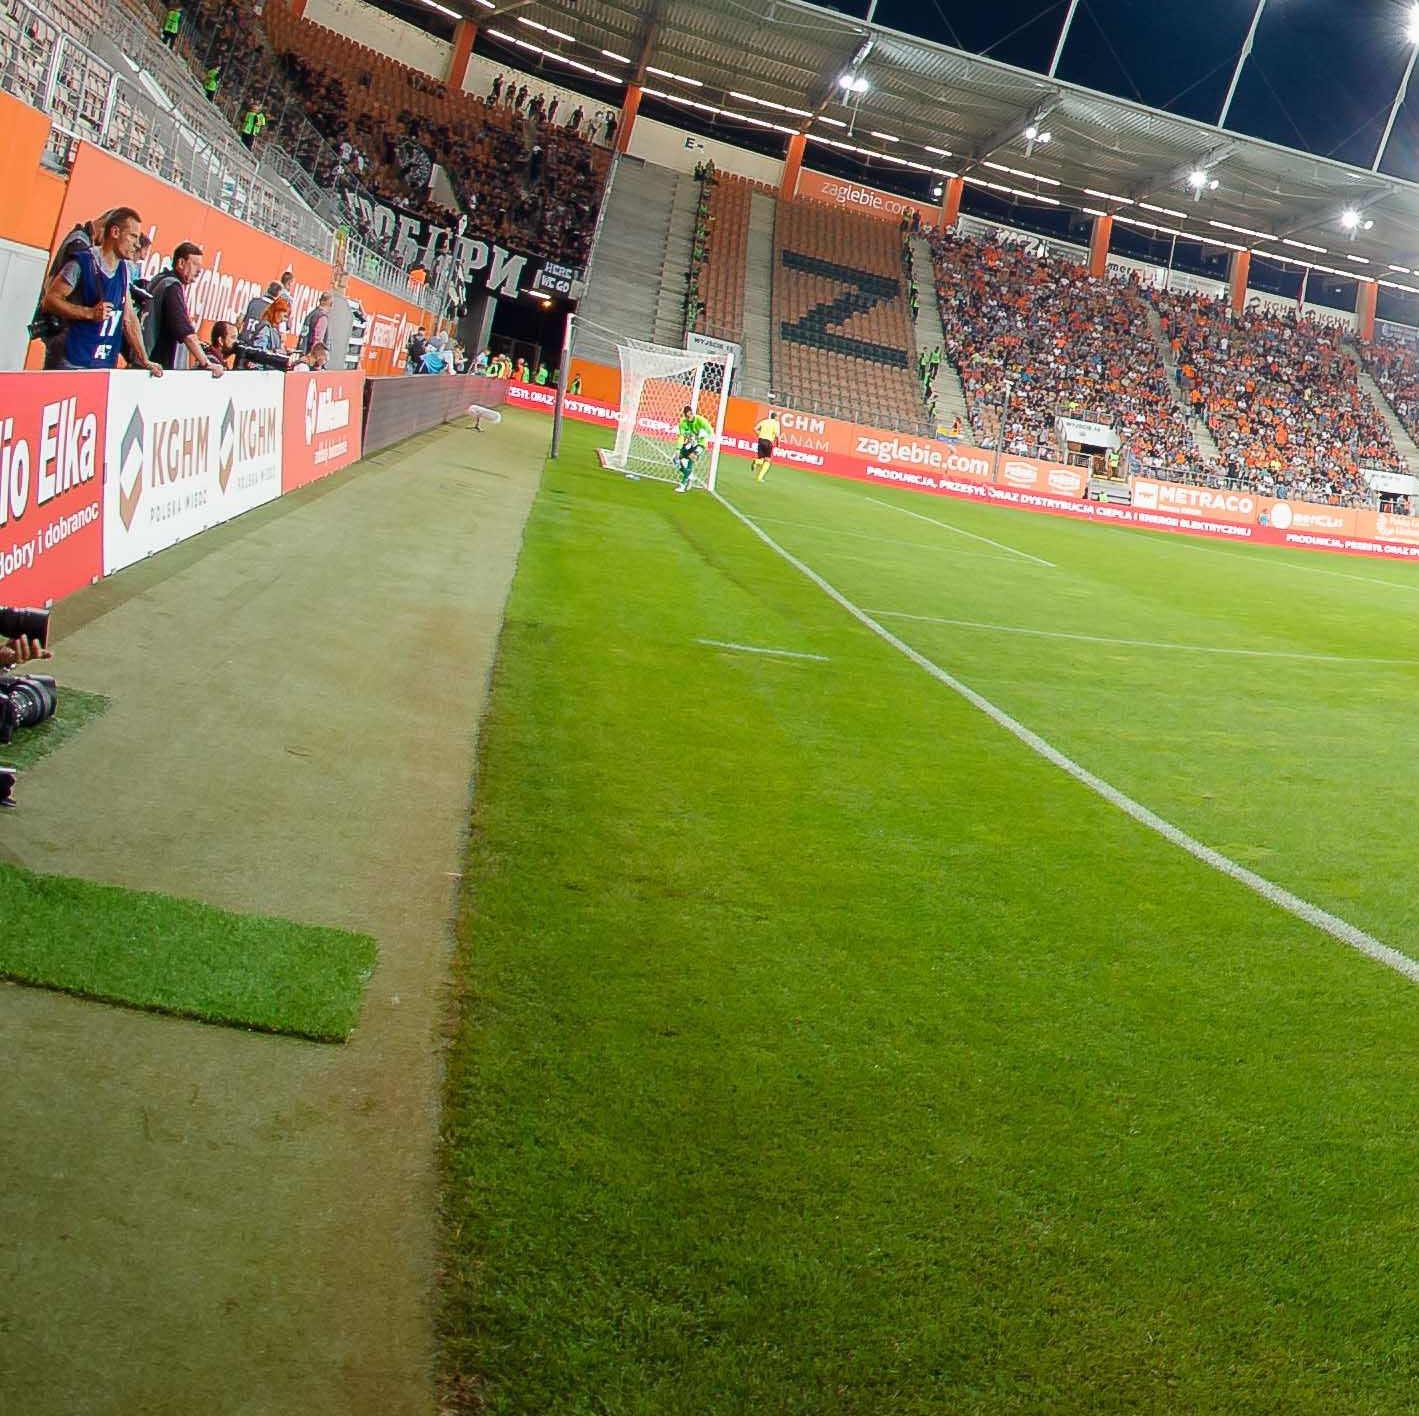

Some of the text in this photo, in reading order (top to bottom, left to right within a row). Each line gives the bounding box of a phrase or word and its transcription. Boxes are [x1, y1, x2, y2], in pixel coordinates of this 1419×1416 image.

[544, 261, 573, 280] HERE
[555, 280, 570, 293] GO
[37, 396, 97, 507] Elka
[151, 416, 210, 488] KGHM
[238, 406, 277, 464] KGHM
[855, 436, 989, 477] zaglebie.com
[1159, 485, 1254, 514] METRACO
[44, 502, 99, 550] dobranoc
